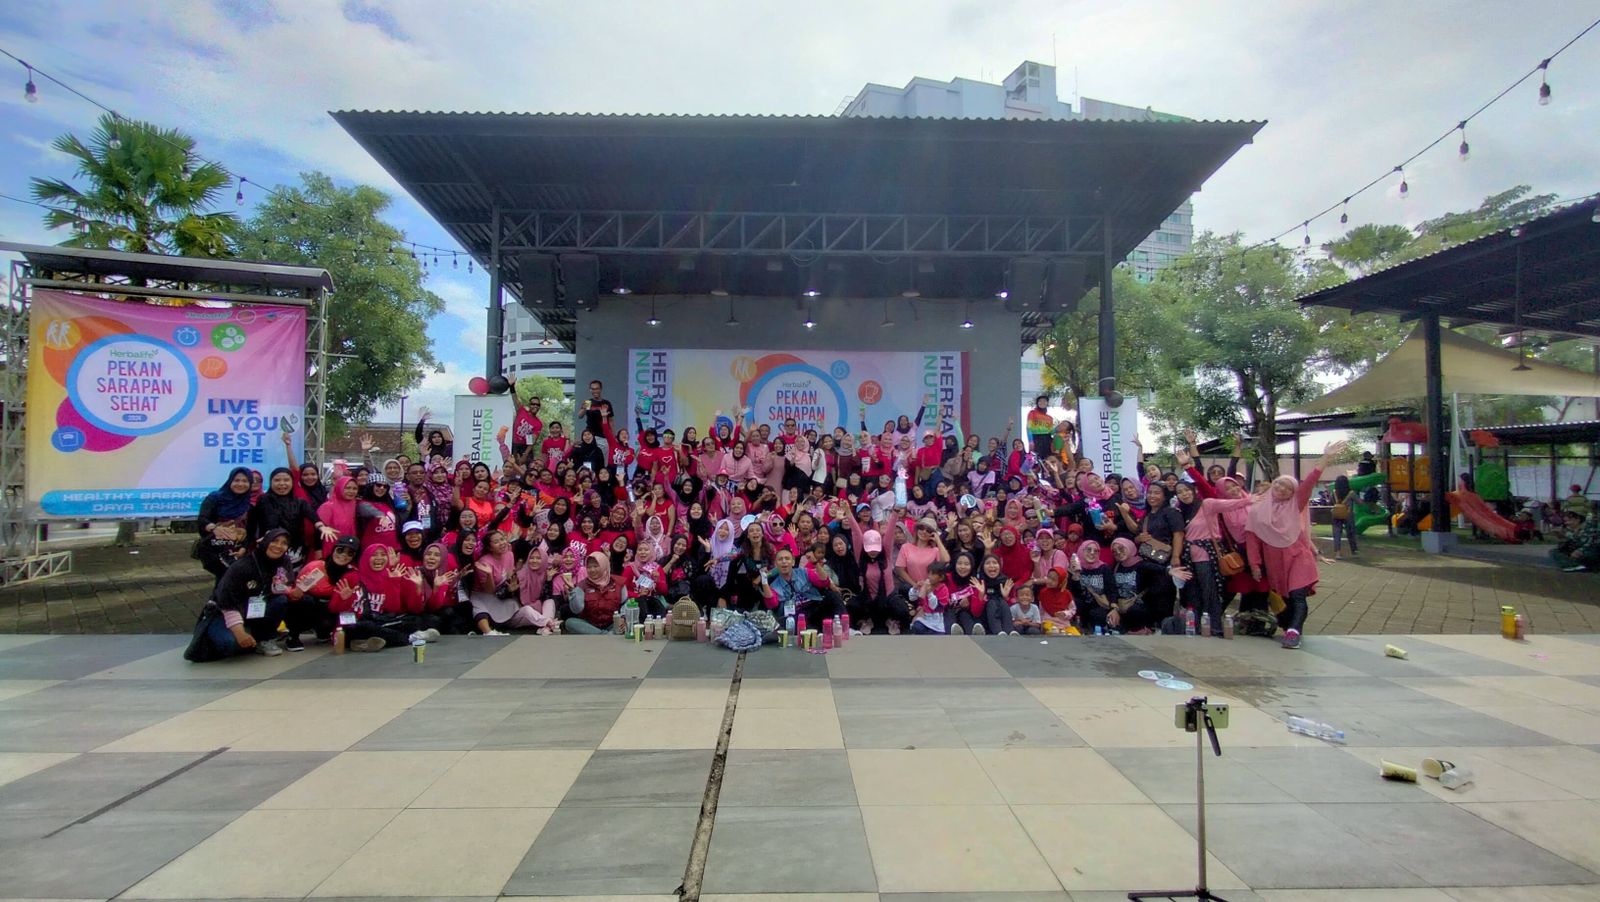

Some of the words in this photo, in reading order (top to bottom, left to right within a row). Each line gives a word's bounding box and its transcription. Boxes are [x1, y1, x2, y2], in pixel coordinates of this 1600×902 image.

[107, 361, 162, 377] PEKAN
[96, 377, 173, 394] SARAPAN
[110, 395, 160, 411] SEHAT
[776, 390, 818, 405] PEKAN
[208, 398, 258, 414] LIVE
[768, 406, 825, 420] SARAPAN
[227, 416, 278, 431] YOU
[203, 432, 266, 447] BEST
[471, 408, 483, 463] BALIFE
[219, 449, 263, 464] LIFE
[63, 493, 133, 502] HEALTHY
[92, 503, 135, 512] DAYA
[142, 501, 193, 510] TAHAN
